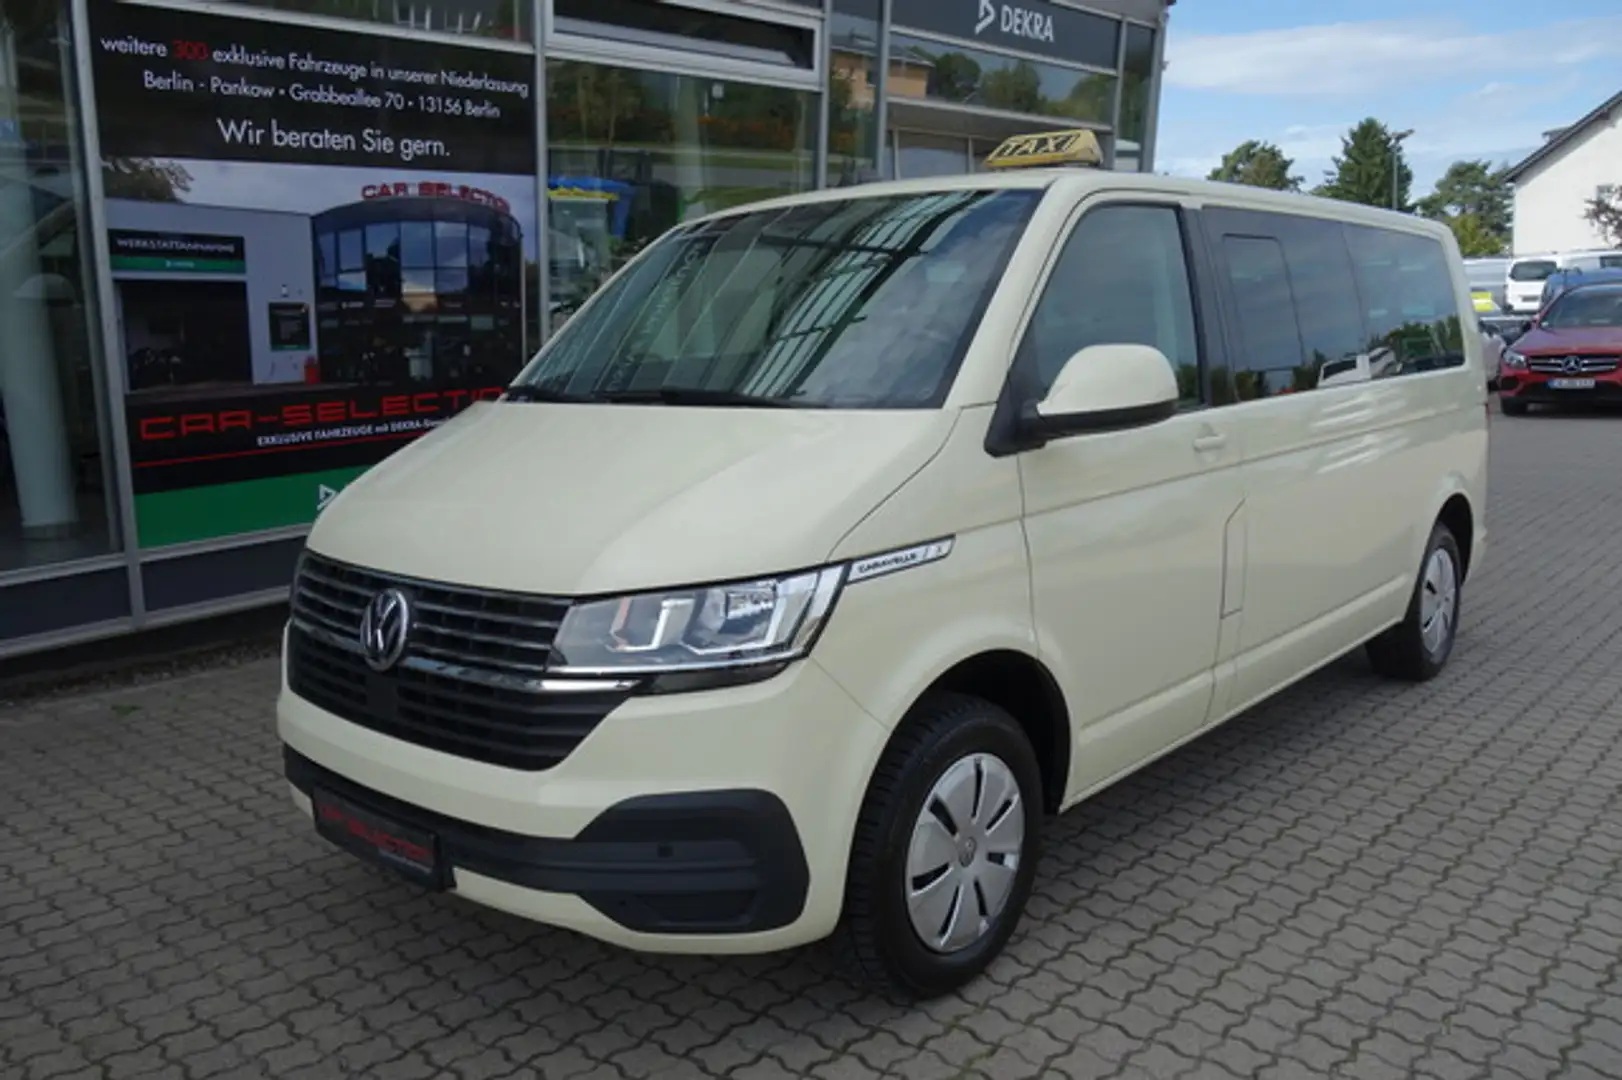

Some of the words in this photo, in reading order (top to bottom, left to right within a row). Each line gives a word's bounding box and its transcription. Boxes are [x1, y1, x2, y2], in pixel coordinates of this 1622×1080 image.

[1000, 4, 1055, 42] DEKRA
[100, 35, 168, 57] weitere
[212, 43, 285, 69] exklusive
[288, 53, 367, 82] Fahrzeuge
[370, 61, 385, 79] in
[388, 69, 437, 85] unserer
[440, 69, 529, 99] Niederlassung
[143, 69, 194, 91] Berlin
[210, 76, 275, 98] Pankow
[384, 91, 405, 110] 70
[418, 95, 462, 116] 13156
[464, 99, 501, 118] Berlin
[216, 116, 265, 146] Wir
[271, 118, 356, 152] beraten
[362, 128, 394, 154] Sie
[400, 138, 450, 161] gern.
[999, 134, 1079, 157] TAXI
